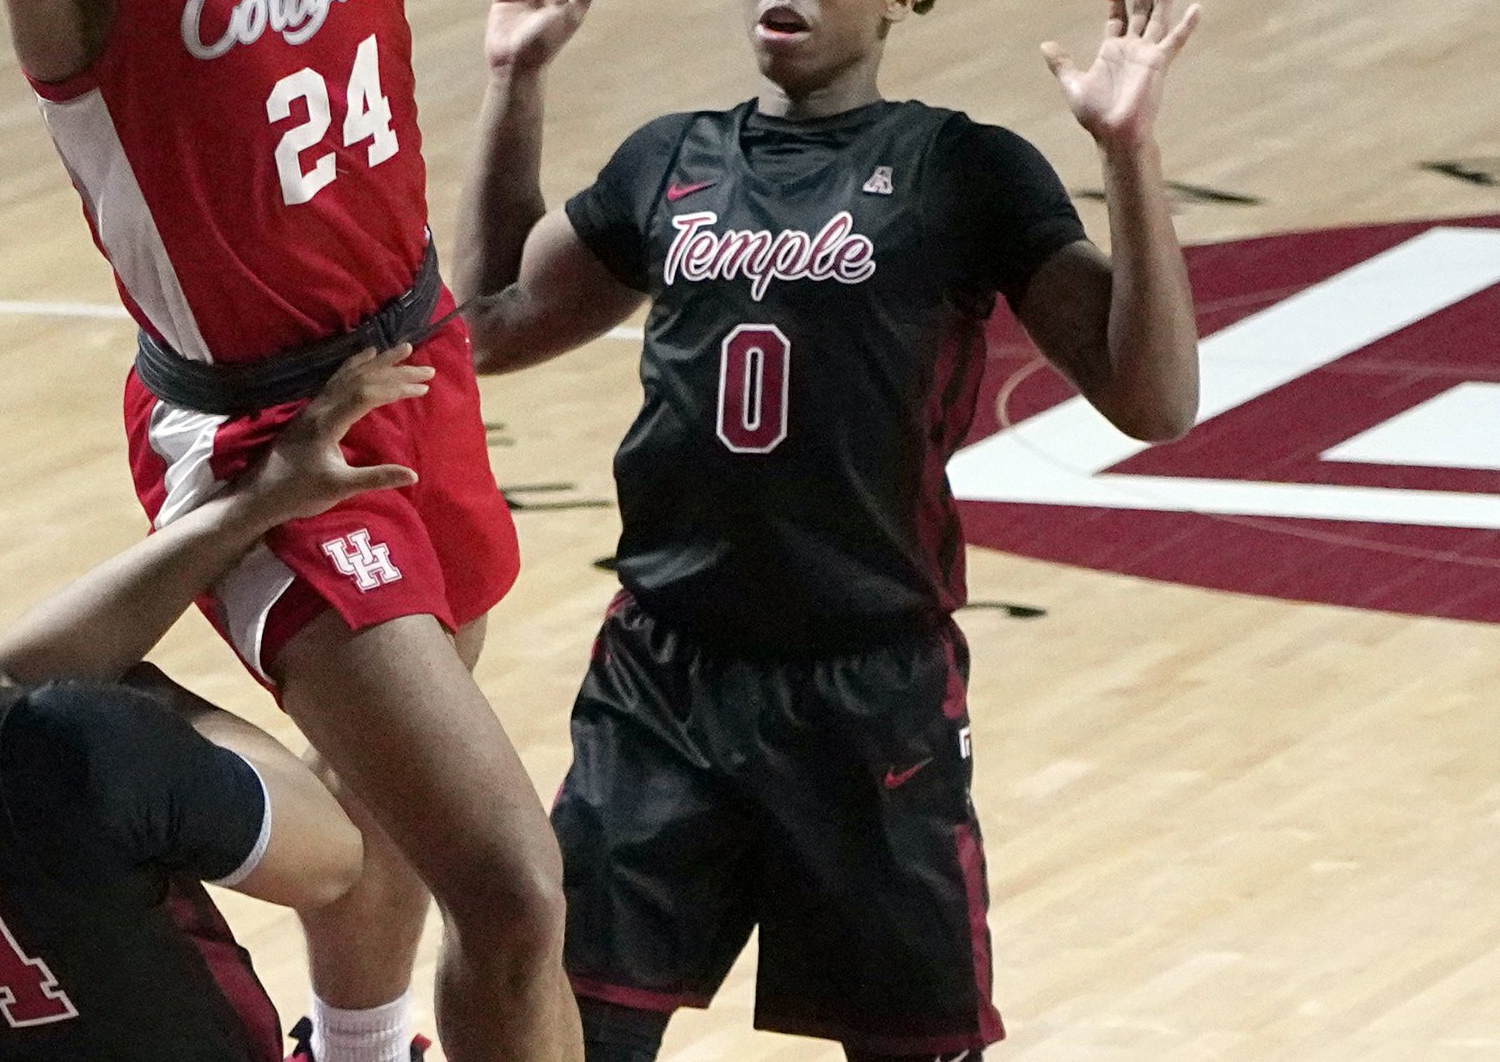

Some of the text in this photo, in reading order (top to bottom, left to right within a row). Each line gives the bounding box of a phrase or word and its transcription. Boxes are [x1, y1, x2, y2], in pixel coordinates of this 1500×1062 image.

[265, 33, 400, 207] 24
[664, 211, 877, 302] Temple
[716, 323, 791, 454] 0
[322, 527, 403, 593] UH
